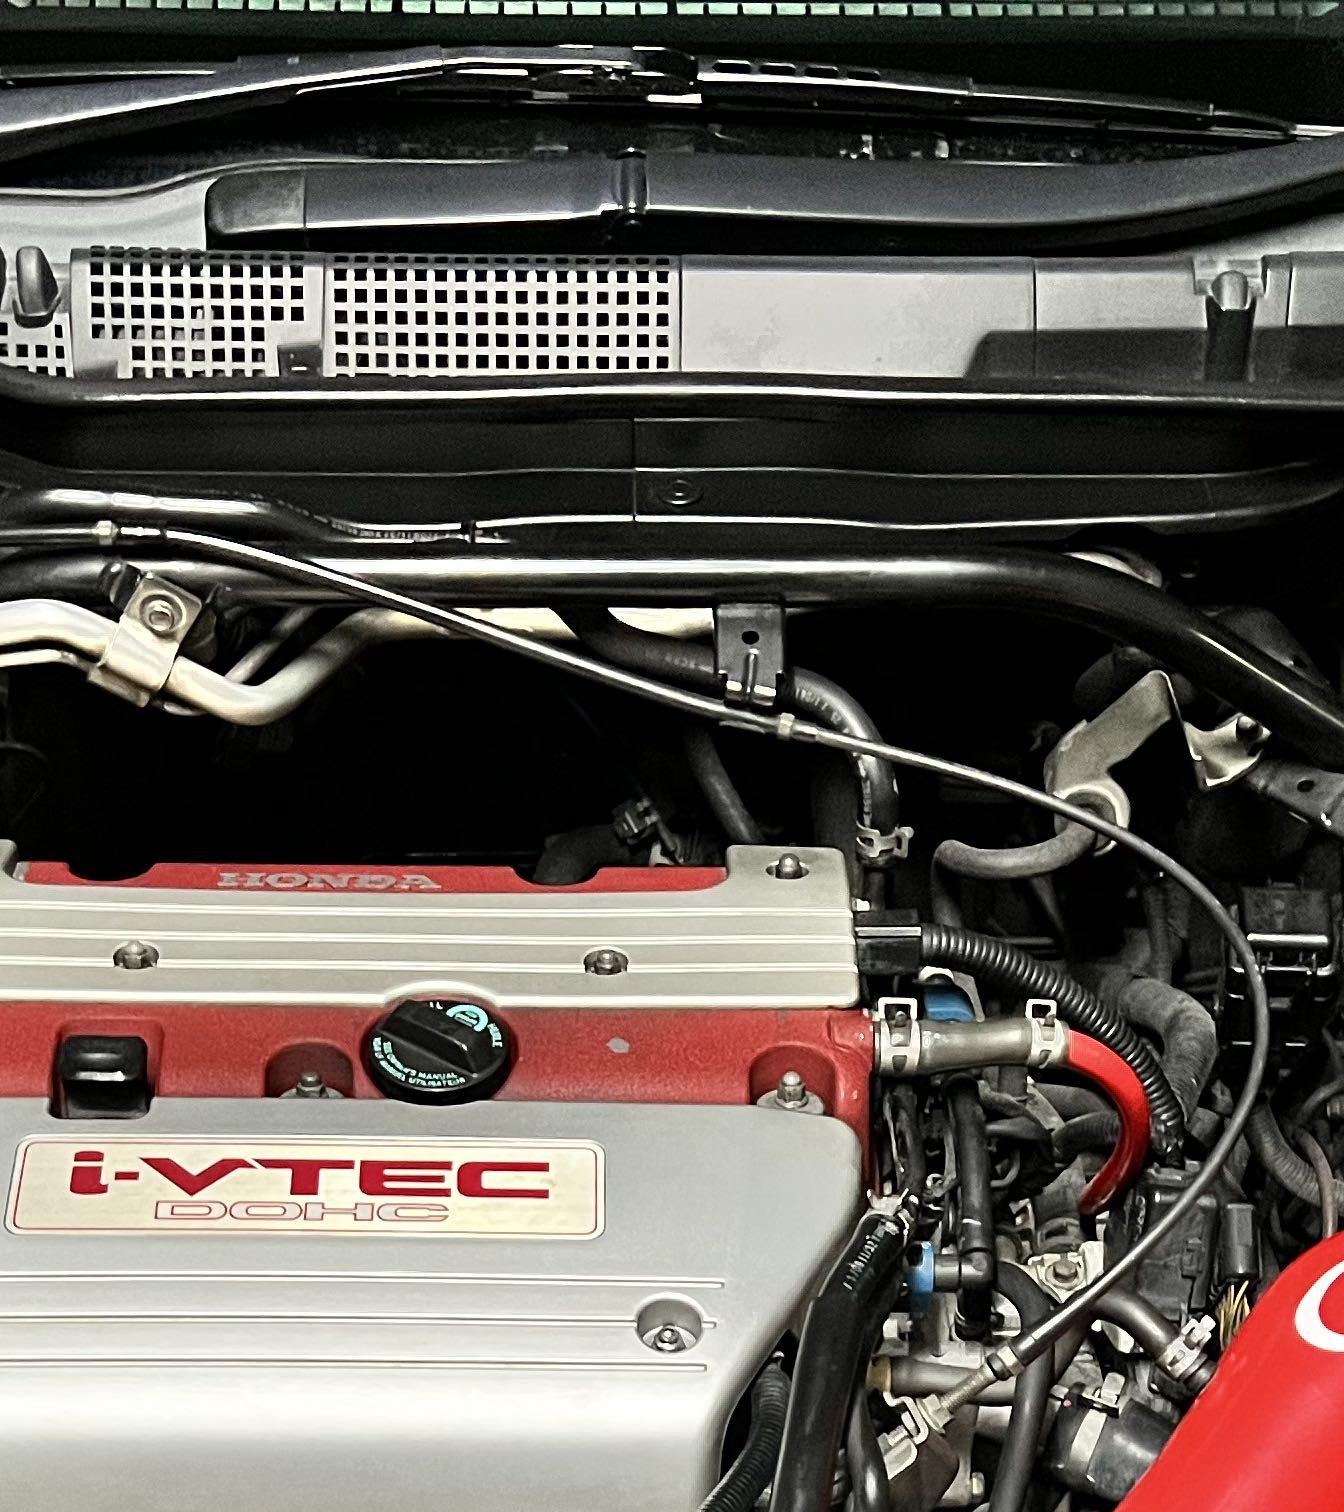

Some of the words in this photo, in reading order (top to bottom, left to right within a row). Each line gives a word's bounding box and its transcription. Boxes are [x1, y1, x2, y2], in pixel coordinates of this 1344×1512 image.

[217, 872, 442, 889] HONDA
[69, 1150, 550, 1198] i-VTEC
[155, 1200, 449, 1222] DOHC
